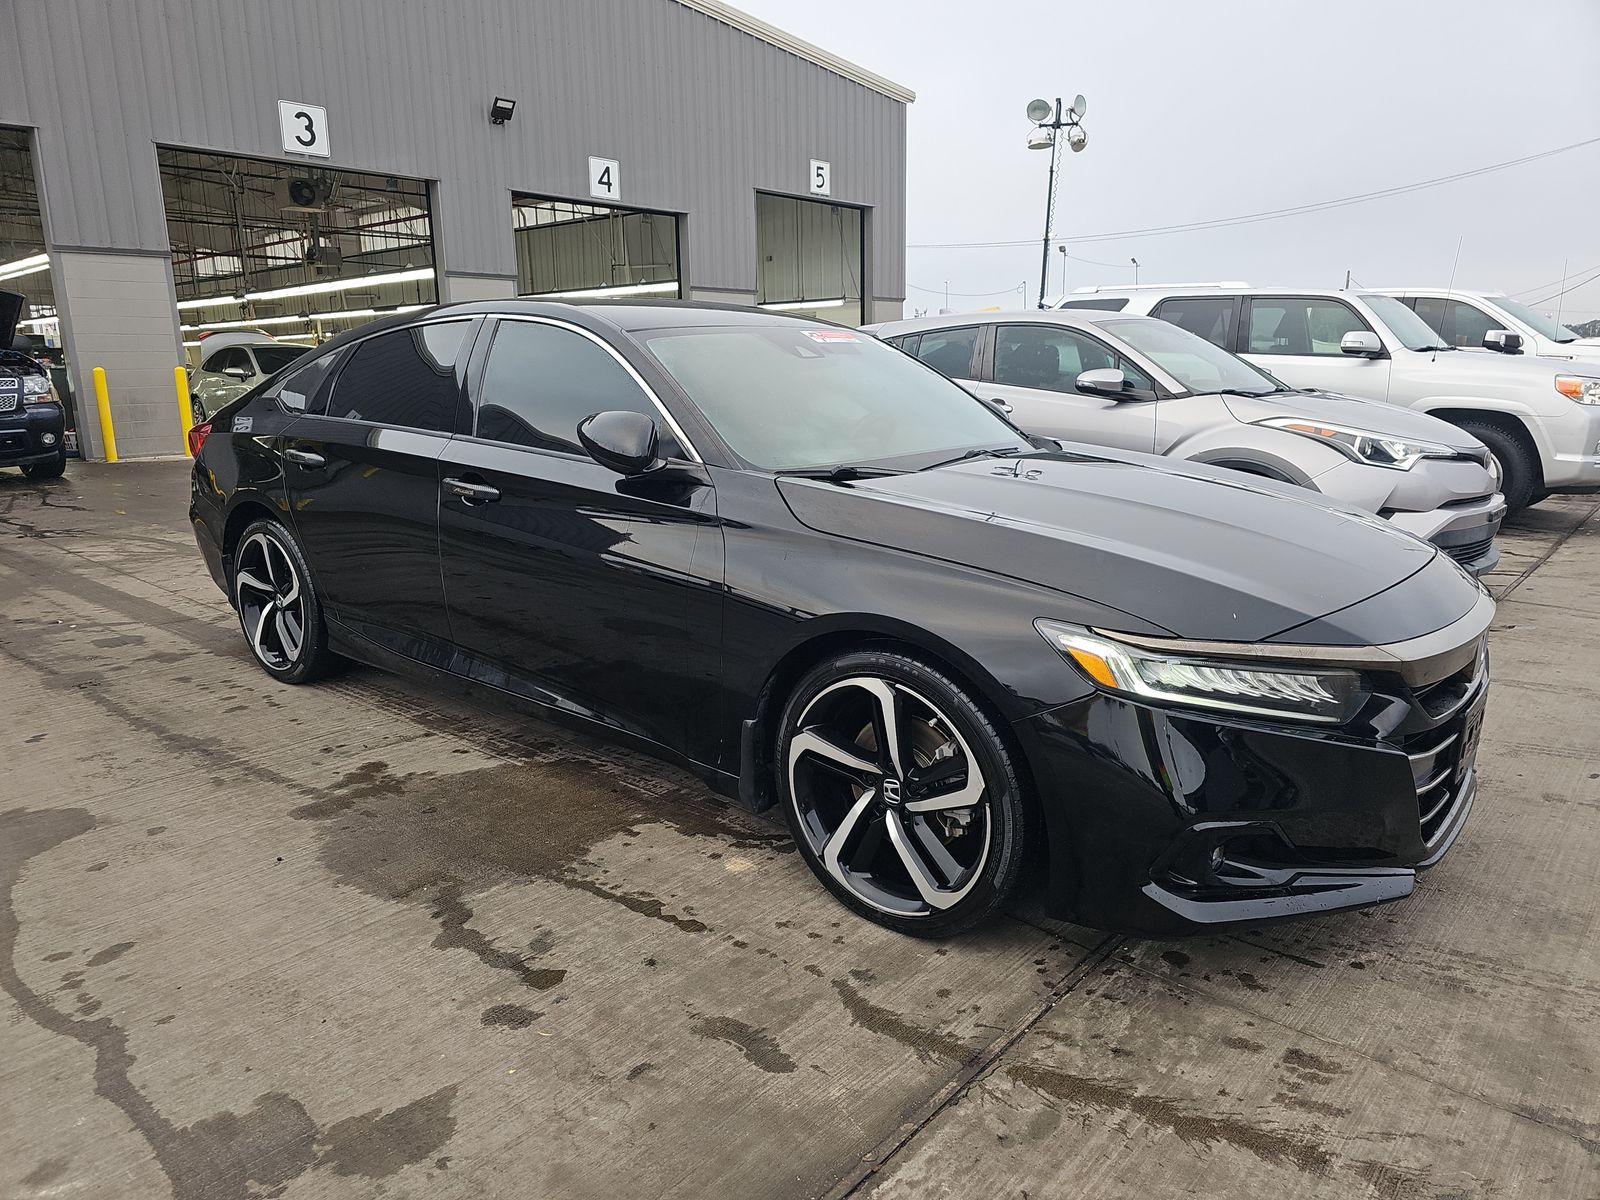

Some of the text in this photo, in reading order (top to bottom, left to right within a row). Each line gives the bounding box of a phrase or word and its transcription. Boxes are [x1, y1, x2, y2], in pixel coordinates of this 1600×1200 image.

[294, 111, 317, 147] 3
[597, 165, 613, 193] 4
[815, 165, 825, 189] 5
